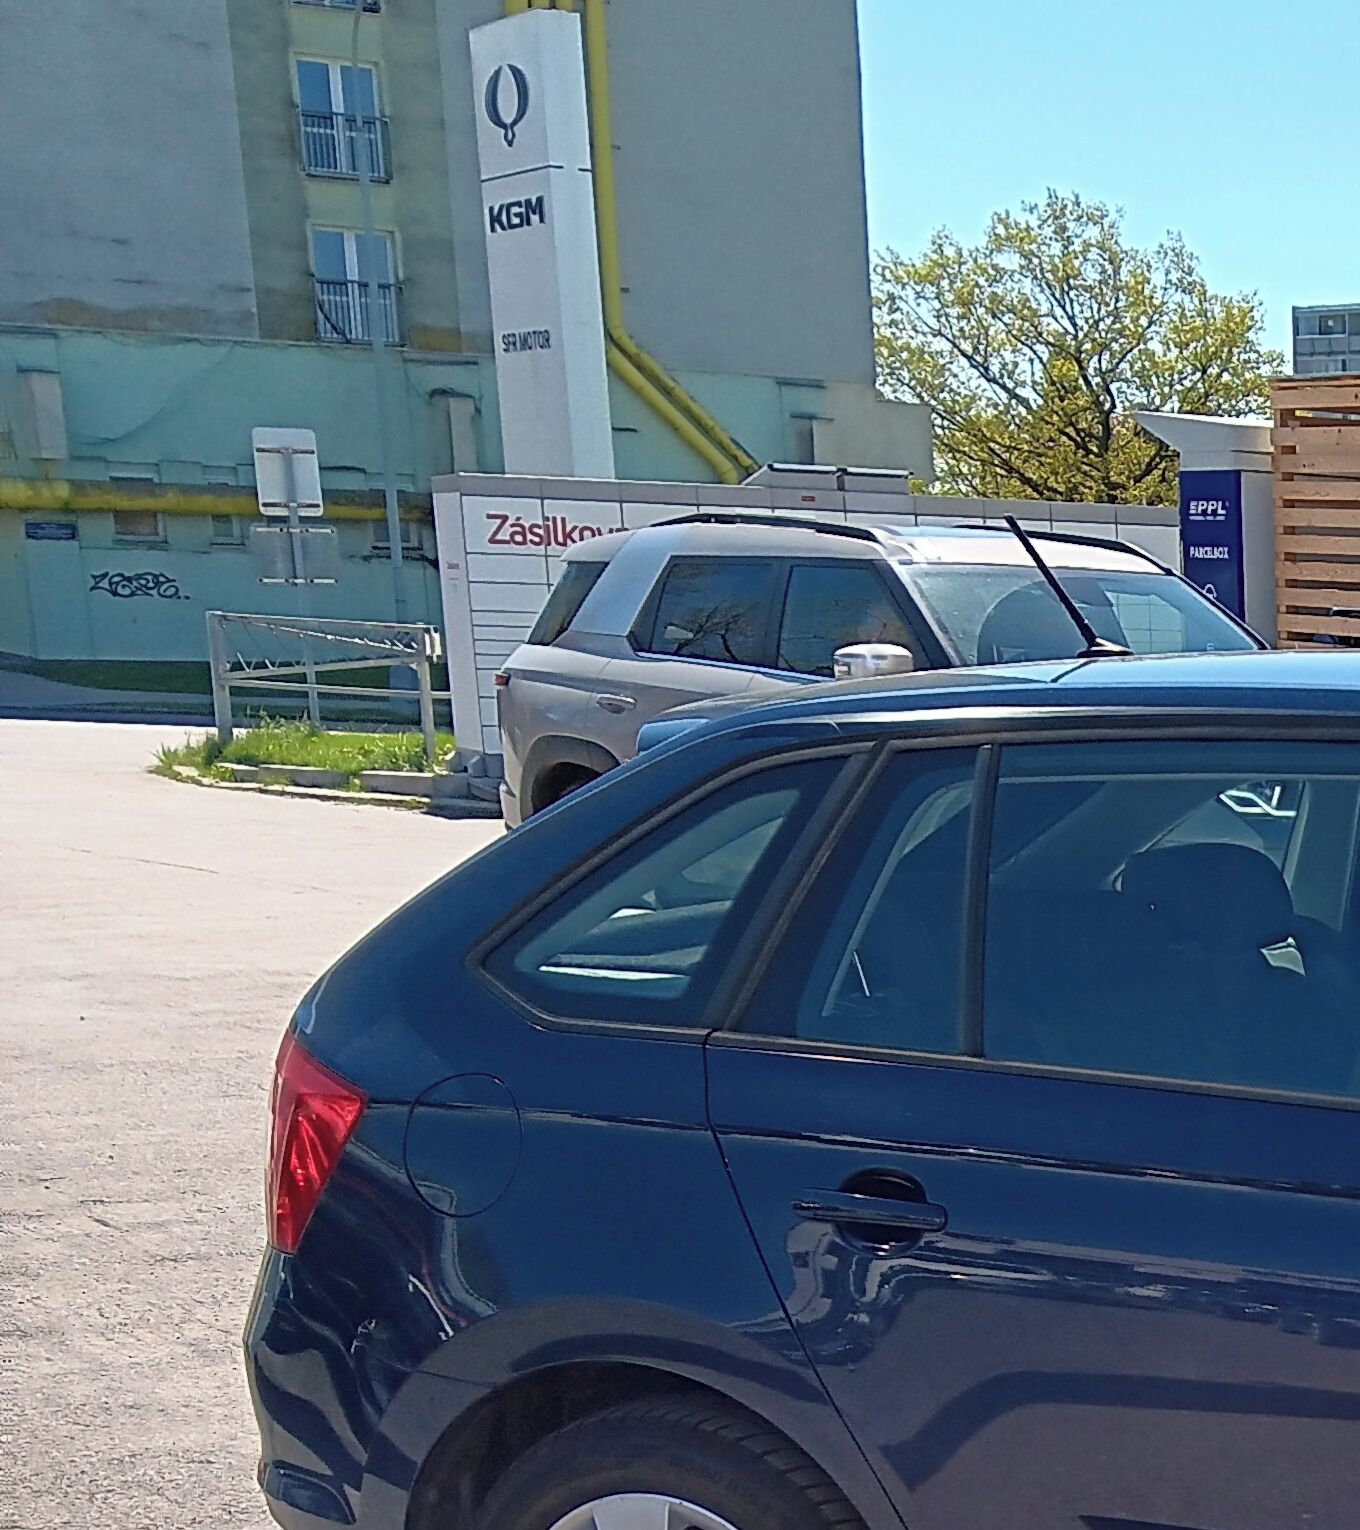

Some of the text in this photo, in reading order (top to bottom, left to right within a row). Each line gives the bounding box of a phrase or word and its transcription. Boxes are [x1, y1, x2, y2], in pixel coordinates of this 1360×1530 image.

[488, 195, 546, 233] KGM
[518, 329, 551, 351] MOTOR
[486, 513, 629, 547] Zásilko
[1189, 546, 1229, 559] PARCELBOX
